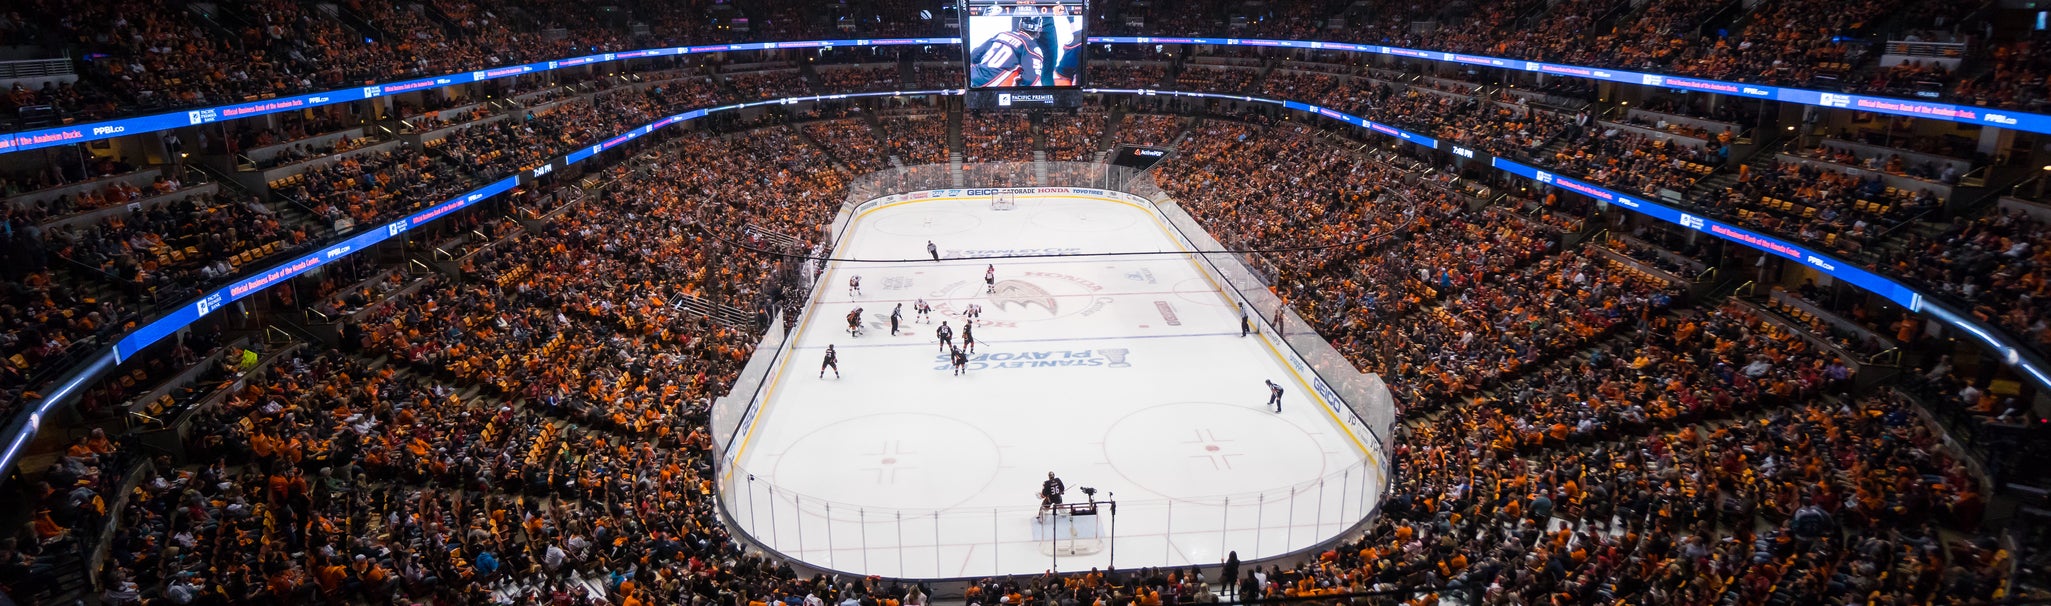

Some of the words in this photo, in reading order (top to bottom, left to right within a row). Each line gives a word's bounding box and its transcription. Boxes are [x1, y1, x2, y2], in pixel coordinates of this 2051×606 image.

[1025, 271, 1104, 293] HONDA
[936, 350, 1094, 363] PLAYOFS
[993, 358, 1103, 369] STANLEY
[1314, 377, 1341, 413] GEICO
[742, 398, 759, 437] GEICO
[1051, 486, 1060, 495] 36
